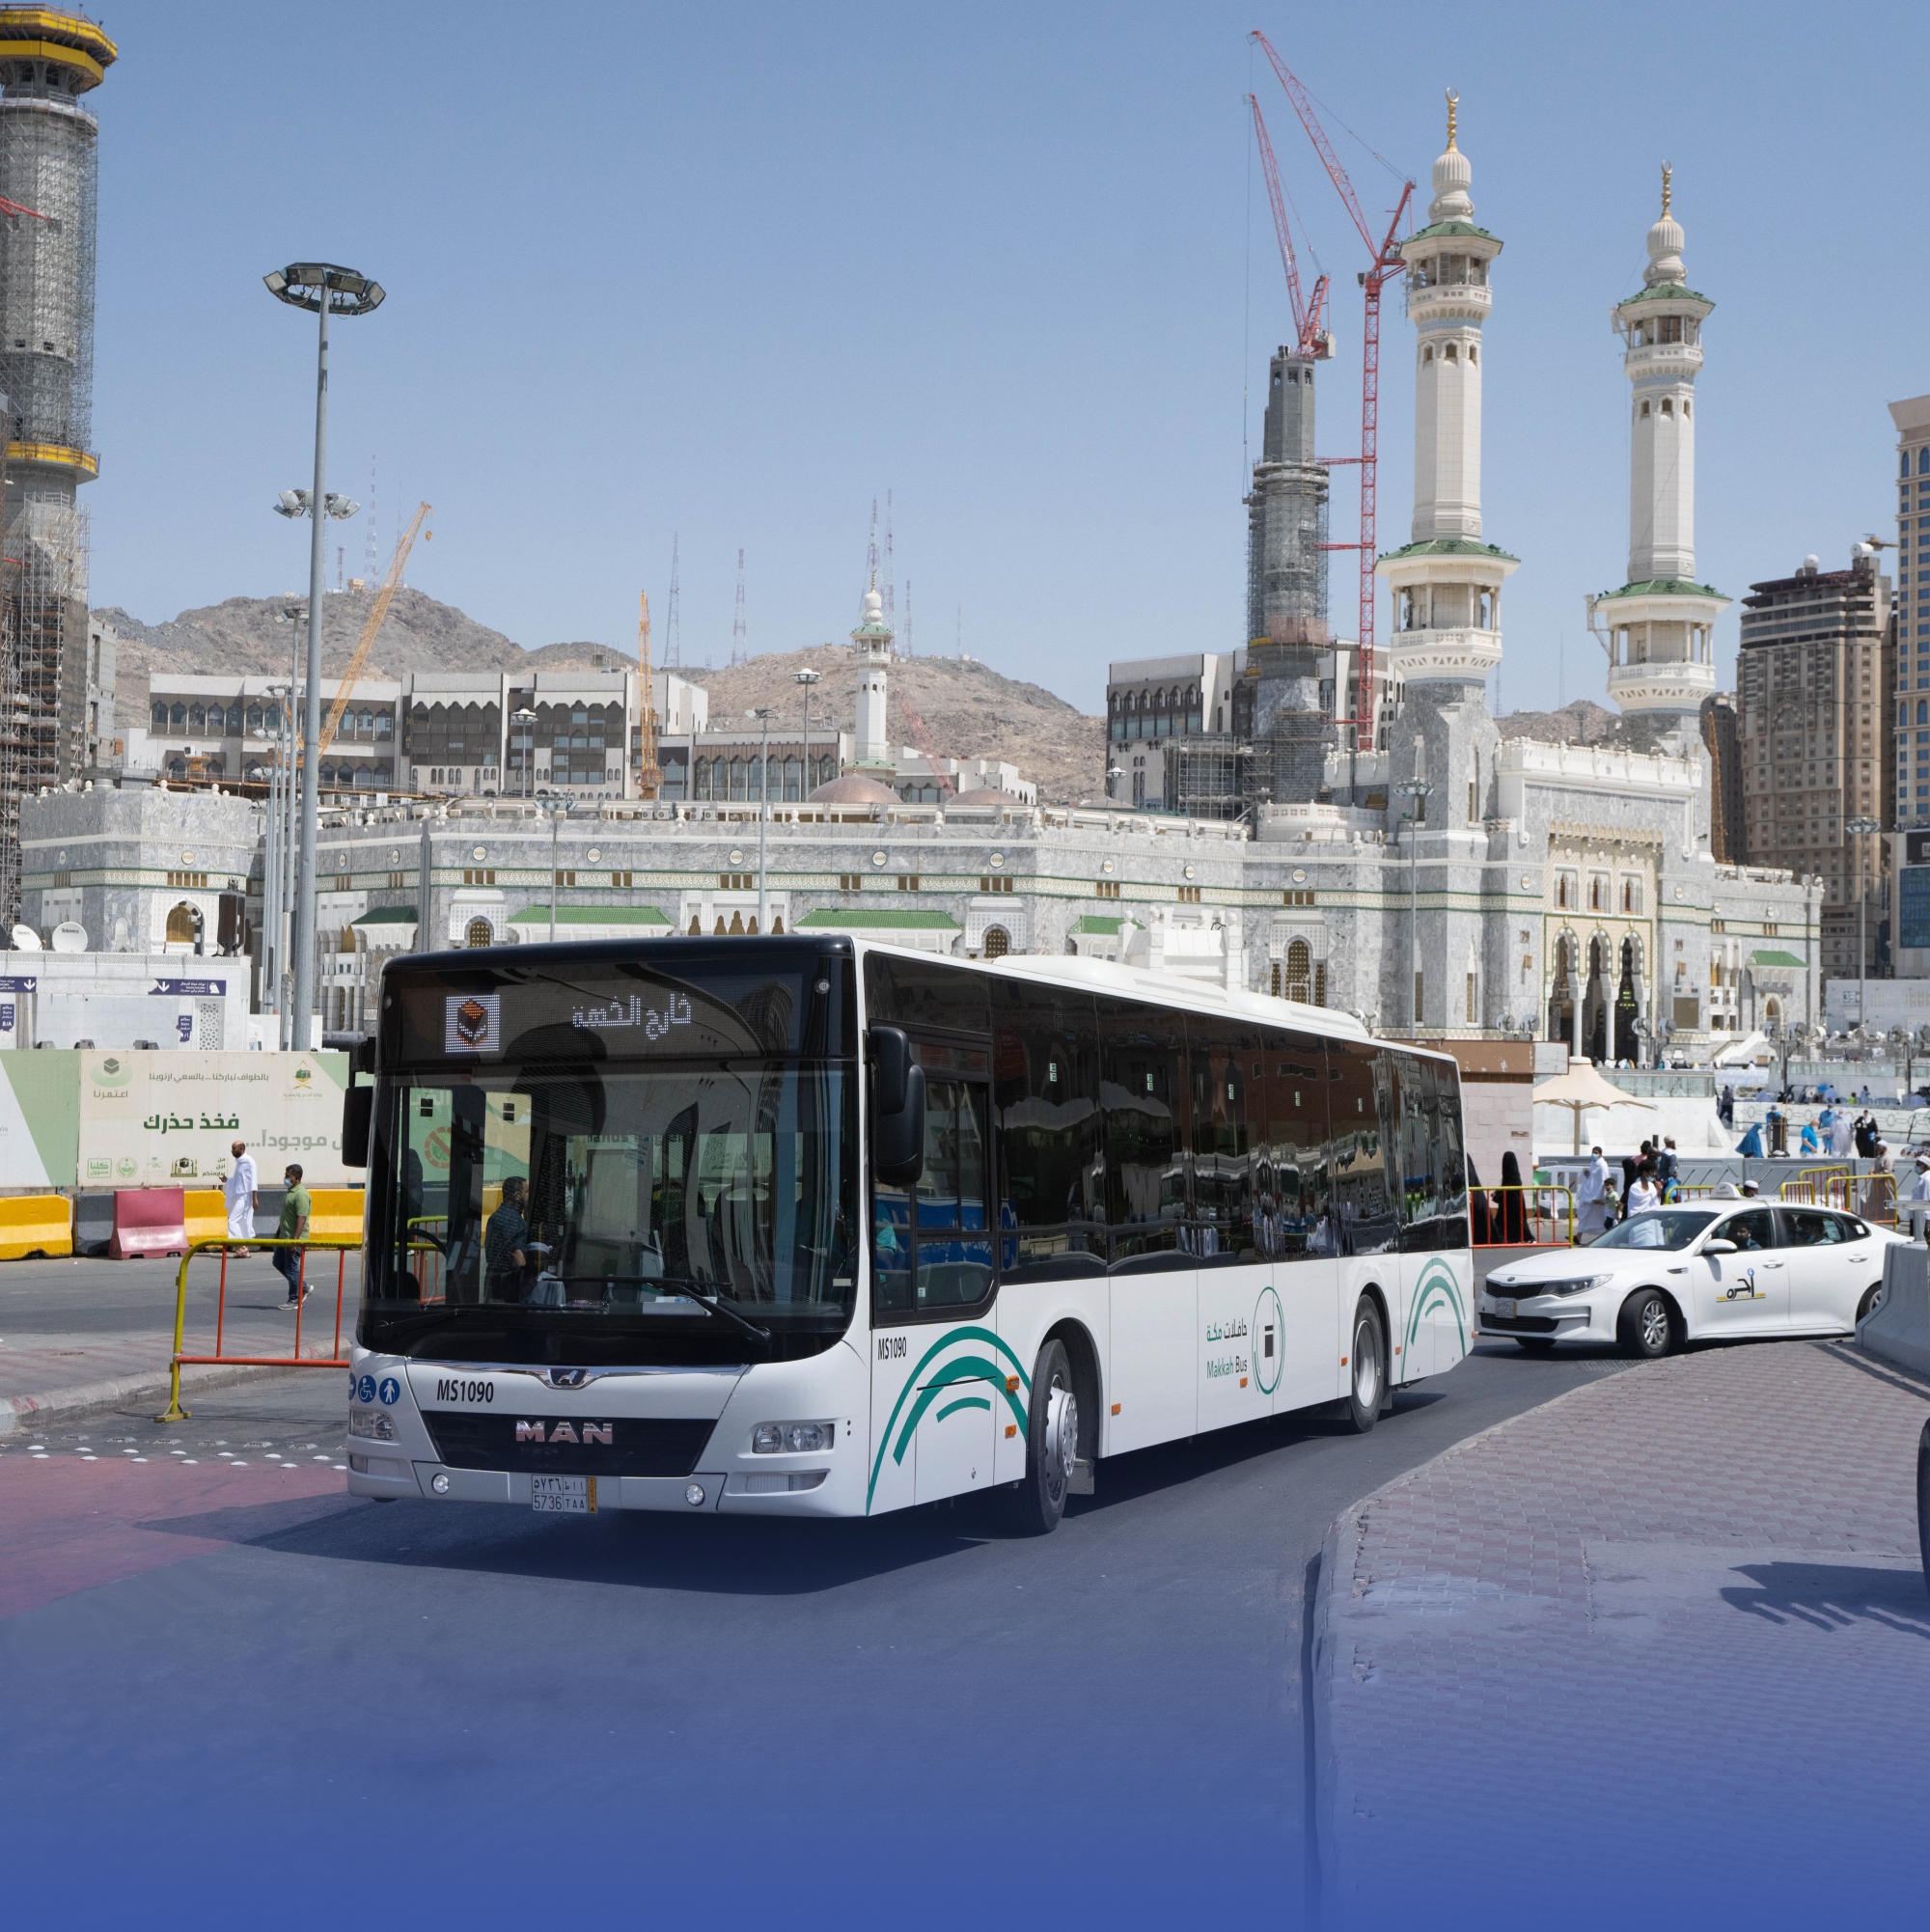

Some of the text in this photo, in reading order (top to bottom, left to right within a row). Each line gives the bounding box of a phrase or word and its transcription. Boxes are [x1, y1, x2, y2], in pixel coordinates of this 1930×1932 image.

[174, 1072, 205, 1084] بالسعي
[237, 1072, 269, 1083] بالطواف
[93, 1090, 128, 1100] اعتمرنا
[143, 1113, 239, 1135] فخذ حذرك
[1206, 1317, 1248, 1342] حافلات مكة
[877, 1337, 907, 1361] MS1090
[1206, 1355, 1248, 1379] Makkah Bus
[436, 1379, 495, 1403] MS1090
[515, 1420, 614, 1445] MAN
[534, 1494, 585, 1510] 5736 TAA
